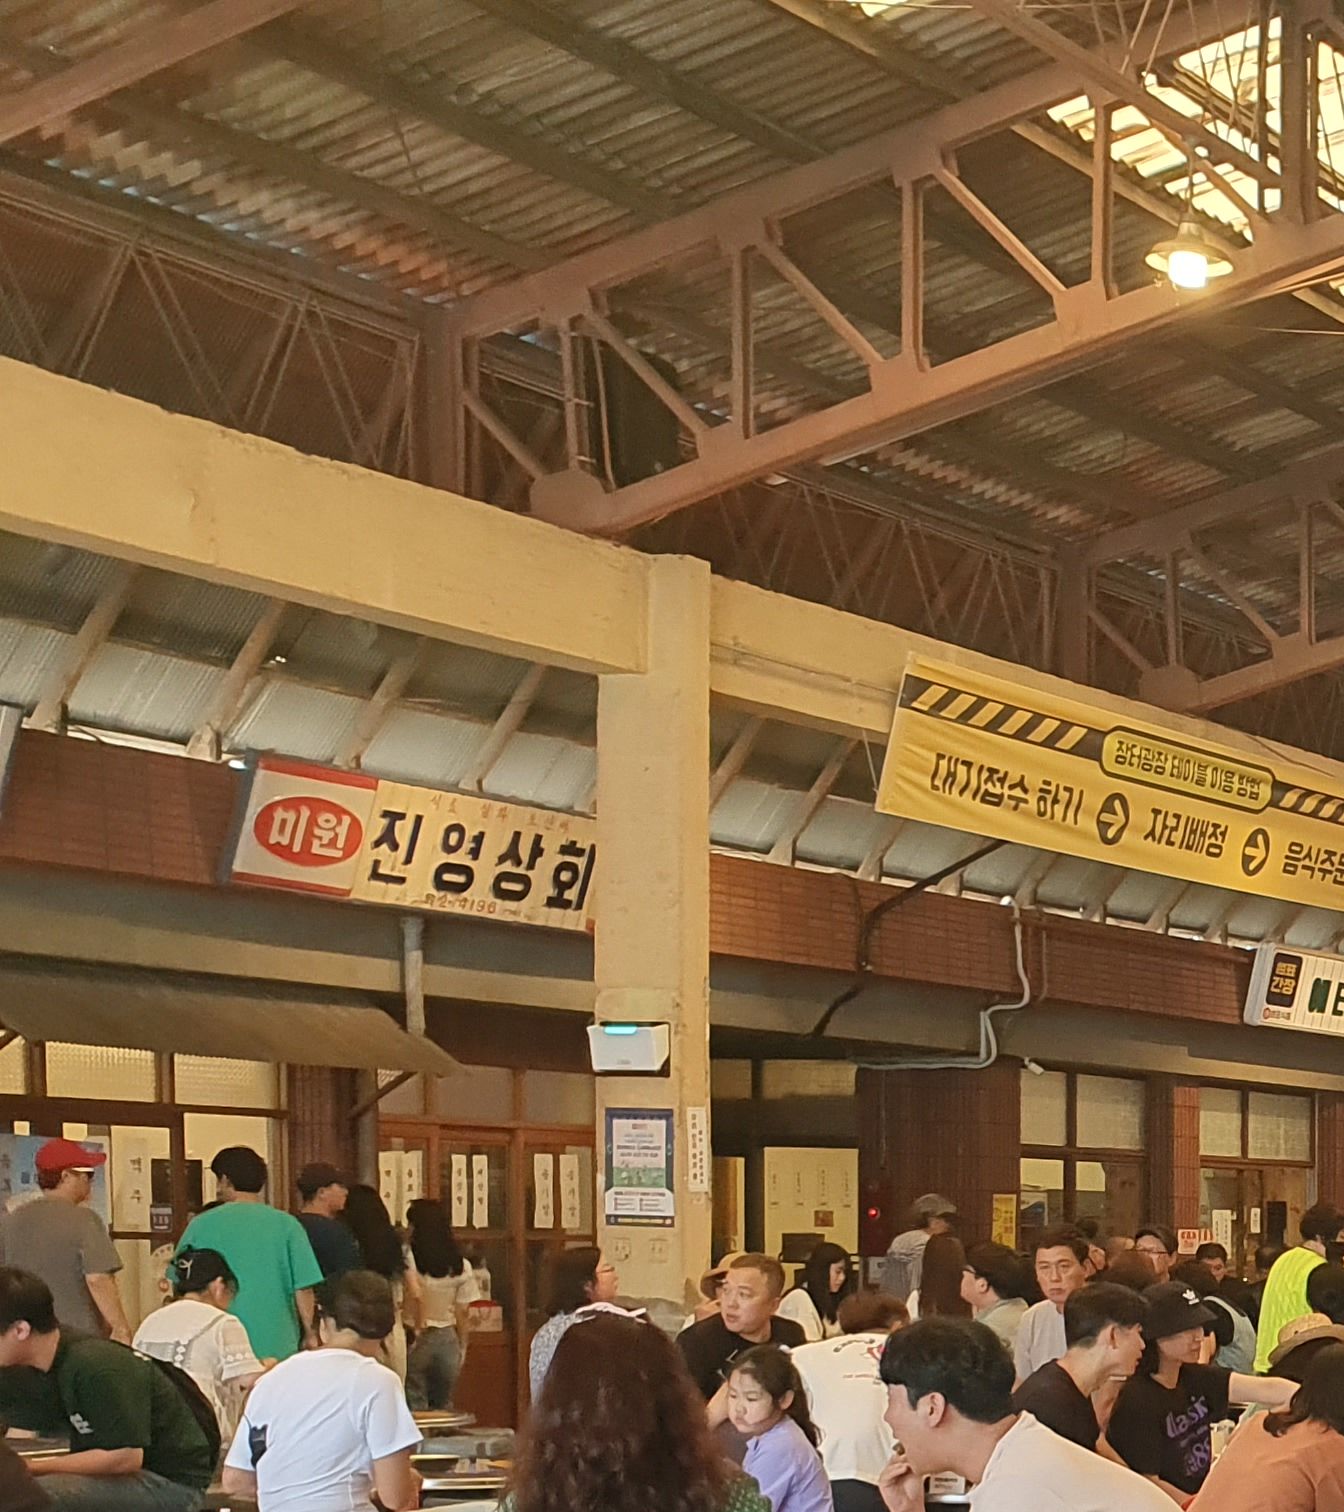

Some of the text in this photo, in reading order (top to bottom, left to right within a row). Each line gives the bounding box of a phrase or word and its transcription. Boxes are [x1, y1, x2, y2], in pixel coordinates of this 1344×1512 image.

[930, 752, 1030, 812] 대기접수
[1036, 779, 1084, 826] 하기
[1143, 807, 1229, 859] 자리배정
[1114, 740, 1262, 801] 장터광장 테이블 이용 방법
[268, 805, 351, 858] 미원
[369, 809, 596, 911] 진영상회
